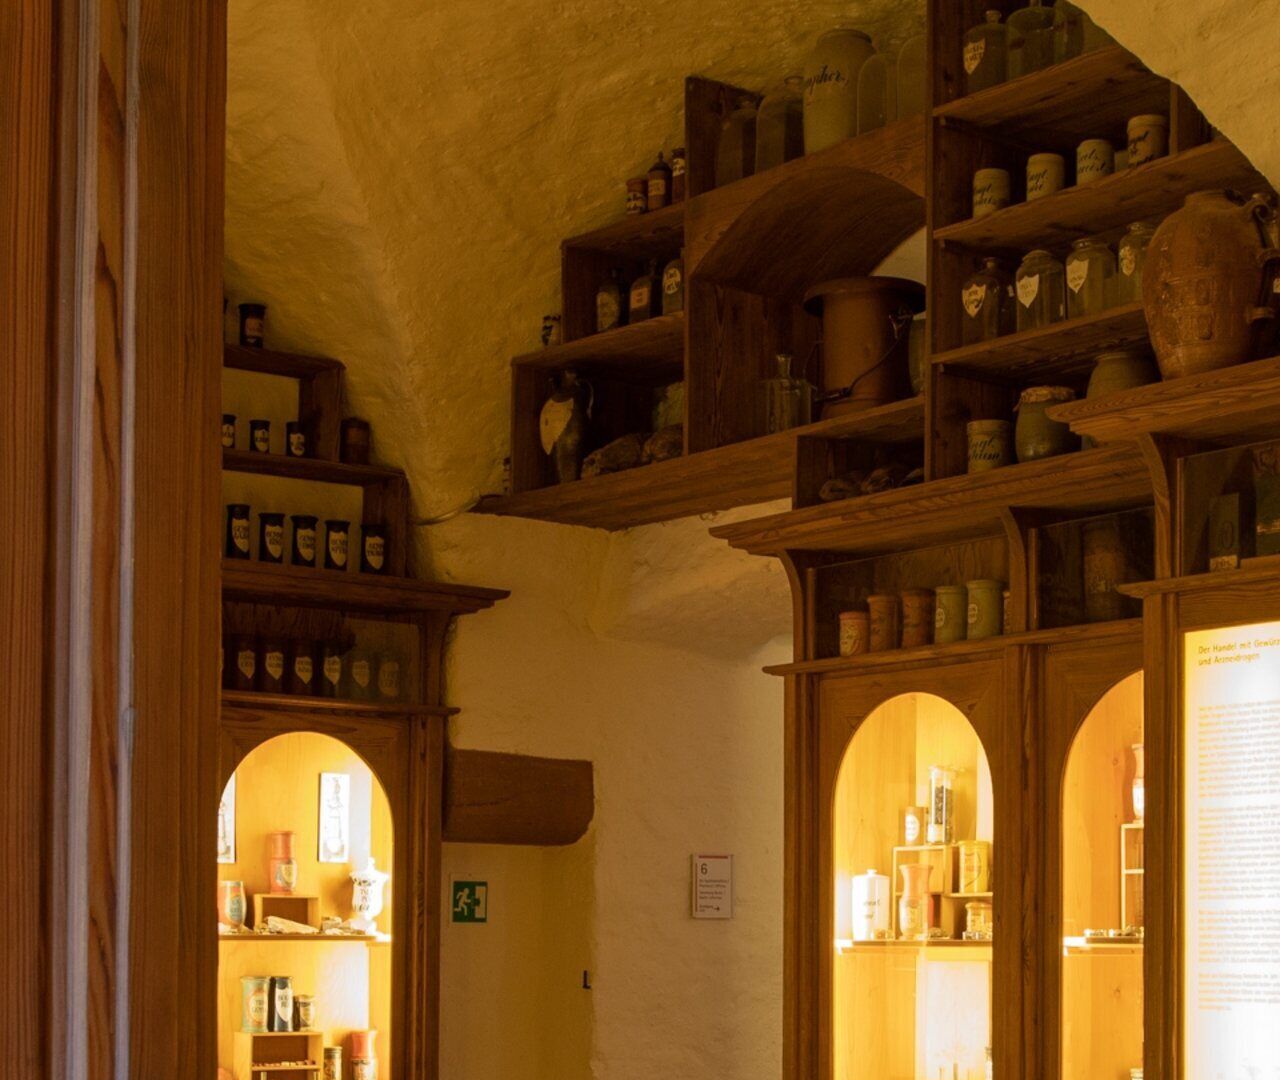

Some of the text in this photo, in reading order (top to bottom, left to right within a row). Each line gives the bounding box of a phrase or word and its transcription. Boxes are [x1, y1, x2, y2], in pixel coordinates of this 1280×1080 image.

[1198, 646, 1210, 655] Der
[1213, 643, 1237, 652] Handel
[1239, 640, 1251, 649] mit
[1198, 652, 1260, 667] und Arzneidrogen
[700, 863, 709, 875] 6
